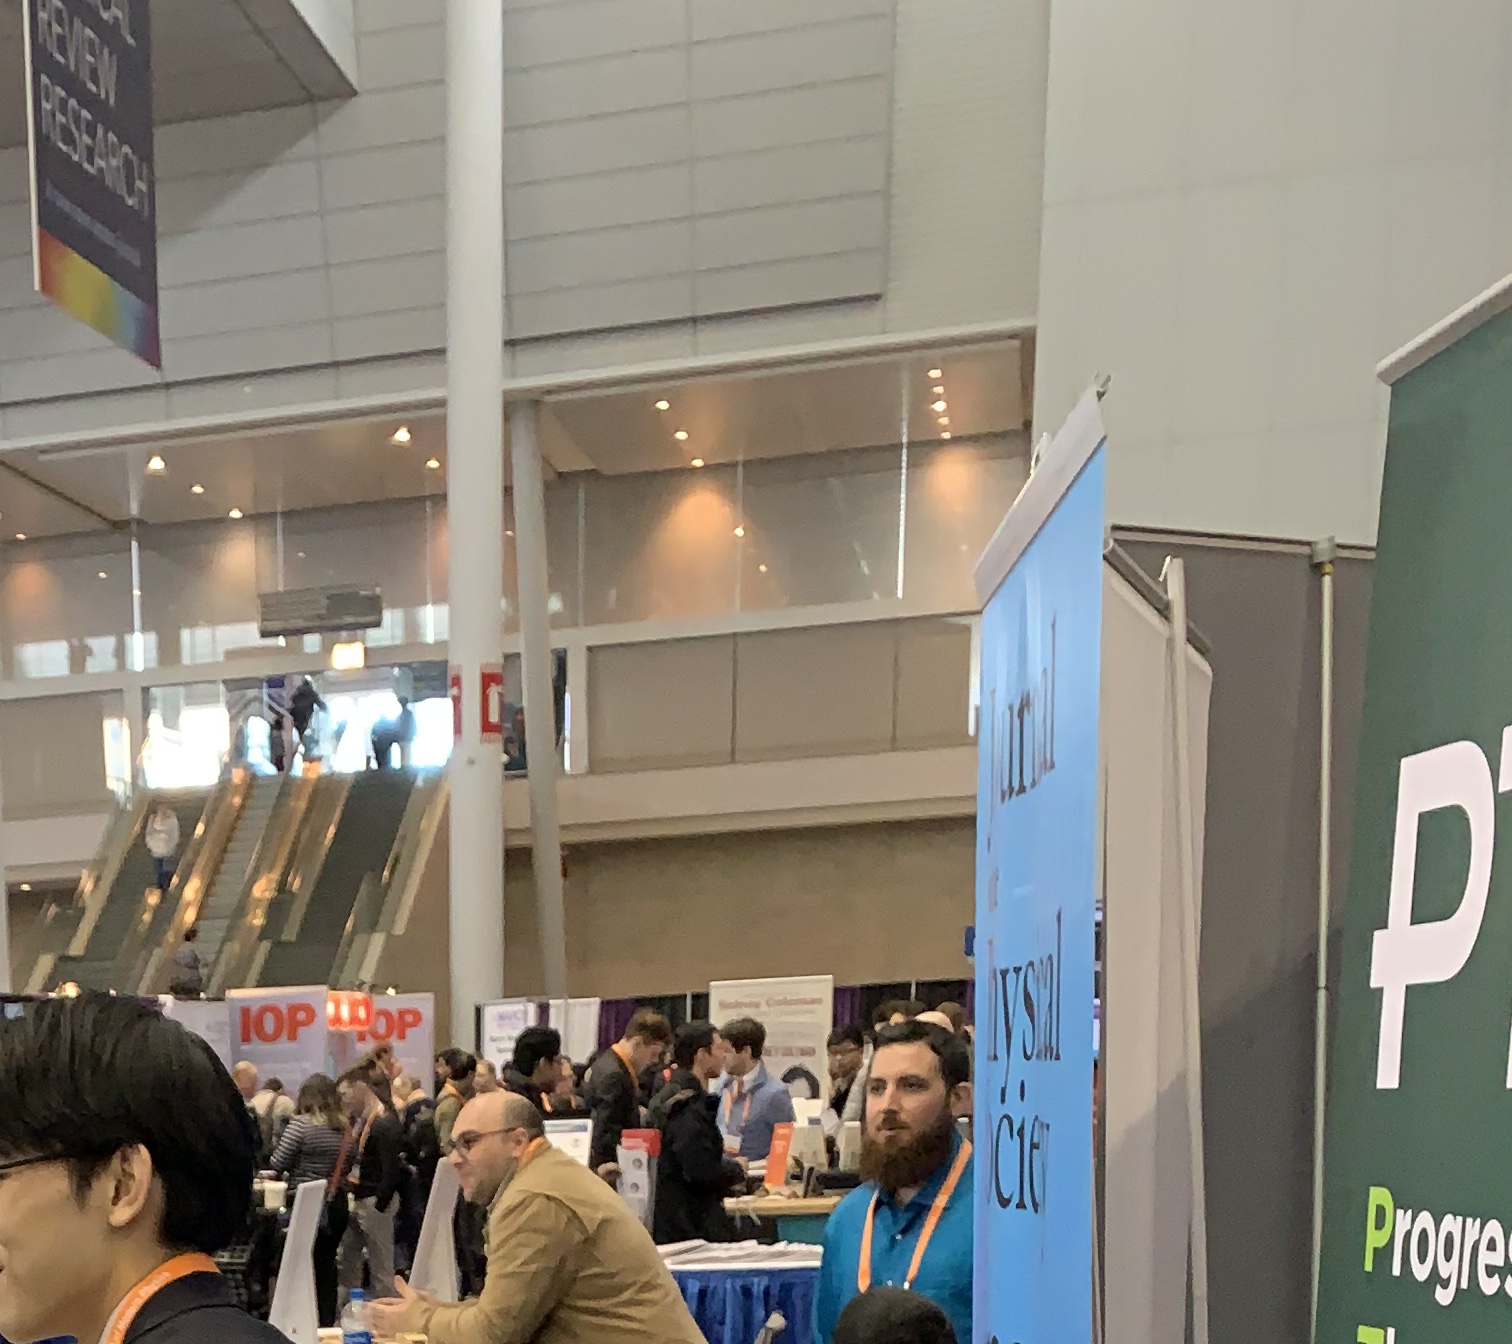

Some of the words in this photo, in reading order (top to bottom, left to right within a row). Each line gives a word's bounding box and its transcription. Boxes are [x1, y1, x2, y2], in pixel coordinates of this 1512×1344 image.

[38, 0, 118, 107] REVIEW
[40, 72, 148, 220] RESEARCH
[239, 1003, 319, 1043] IOP
